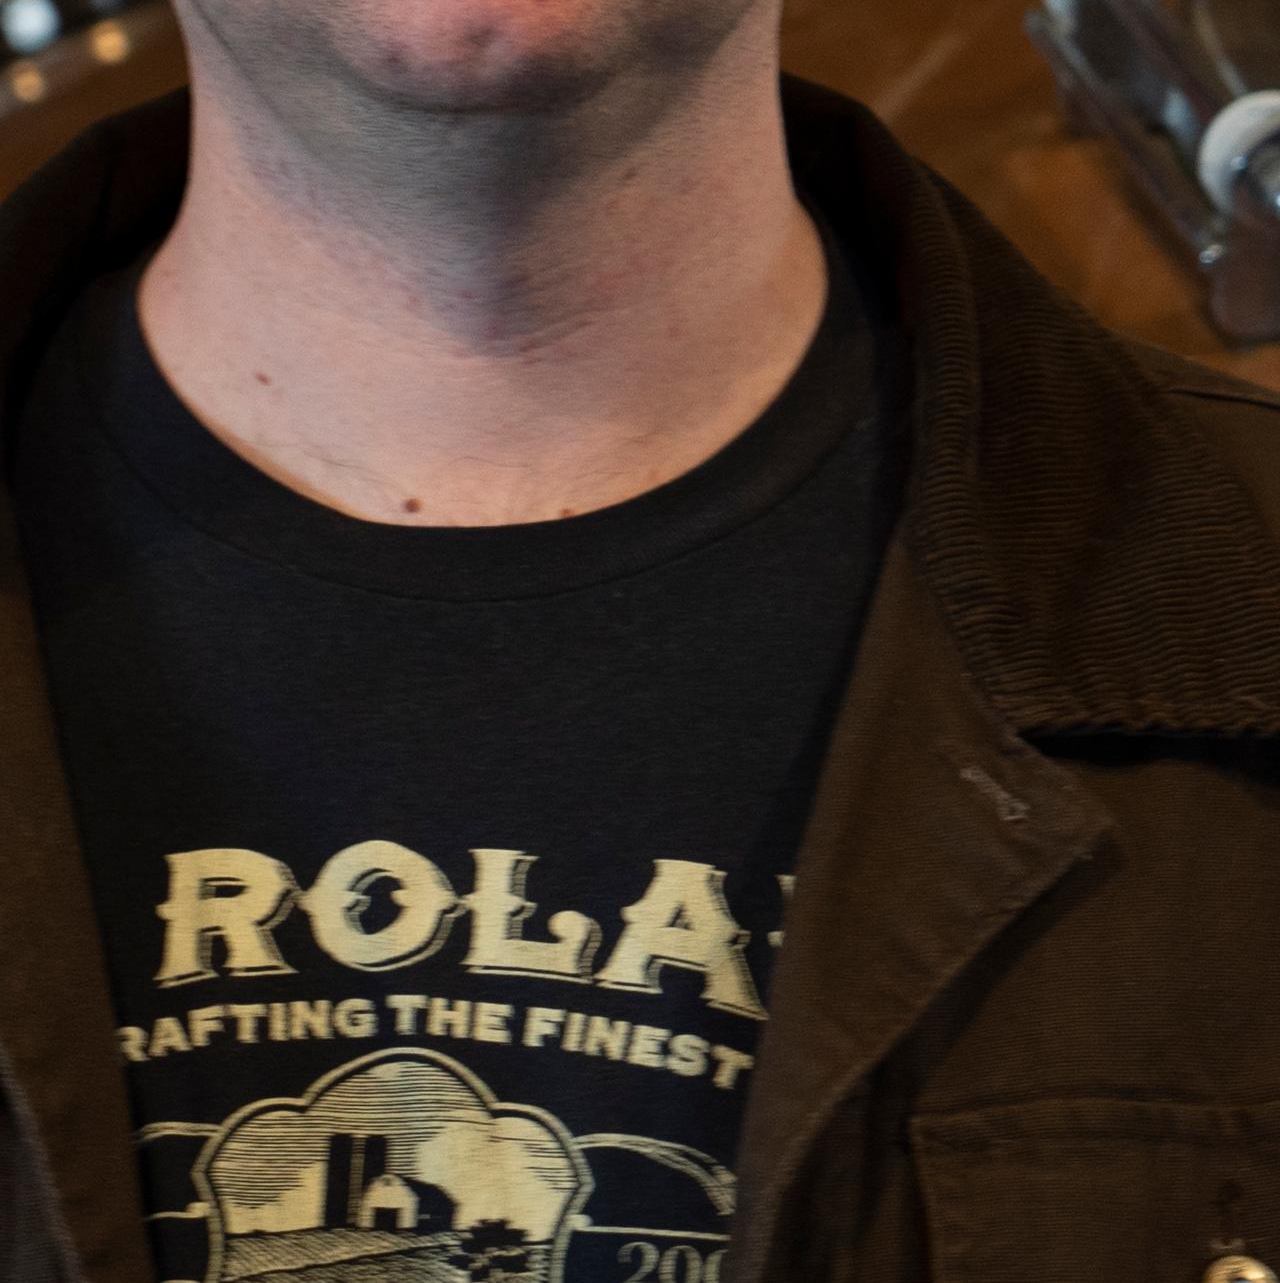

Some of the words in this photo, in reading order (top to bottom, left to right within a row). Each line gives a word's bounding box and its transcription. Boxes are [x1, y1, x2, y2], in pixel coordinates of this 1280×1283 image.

[156, 839, 797, 1020] ROLA
[385, 994, 513, 1044] THE
[522, 1007, 754, 1090] FINEST
